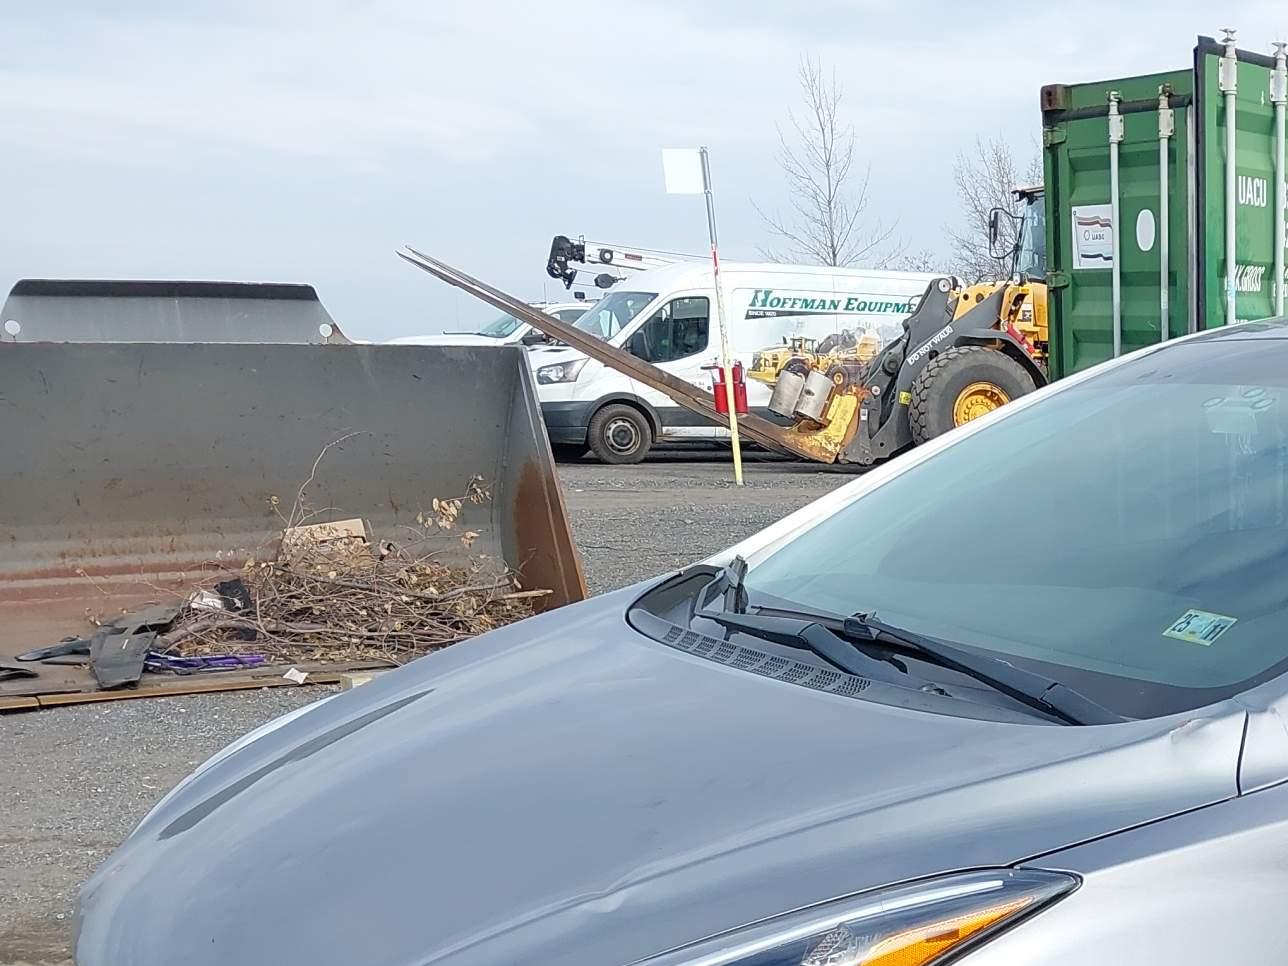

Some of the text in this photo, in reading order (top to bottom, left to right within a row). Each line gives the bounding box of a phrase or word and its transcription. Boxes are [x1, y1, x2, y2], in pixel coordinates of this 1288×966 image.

[1238, 175, 1267, 207] UACU
[749, 289, 842, 311] HOFFMAN
[907, 352, 920, 365] DO
[919, 340, 934, 357] NOT
[1171, 613, 1201, 633] 25
